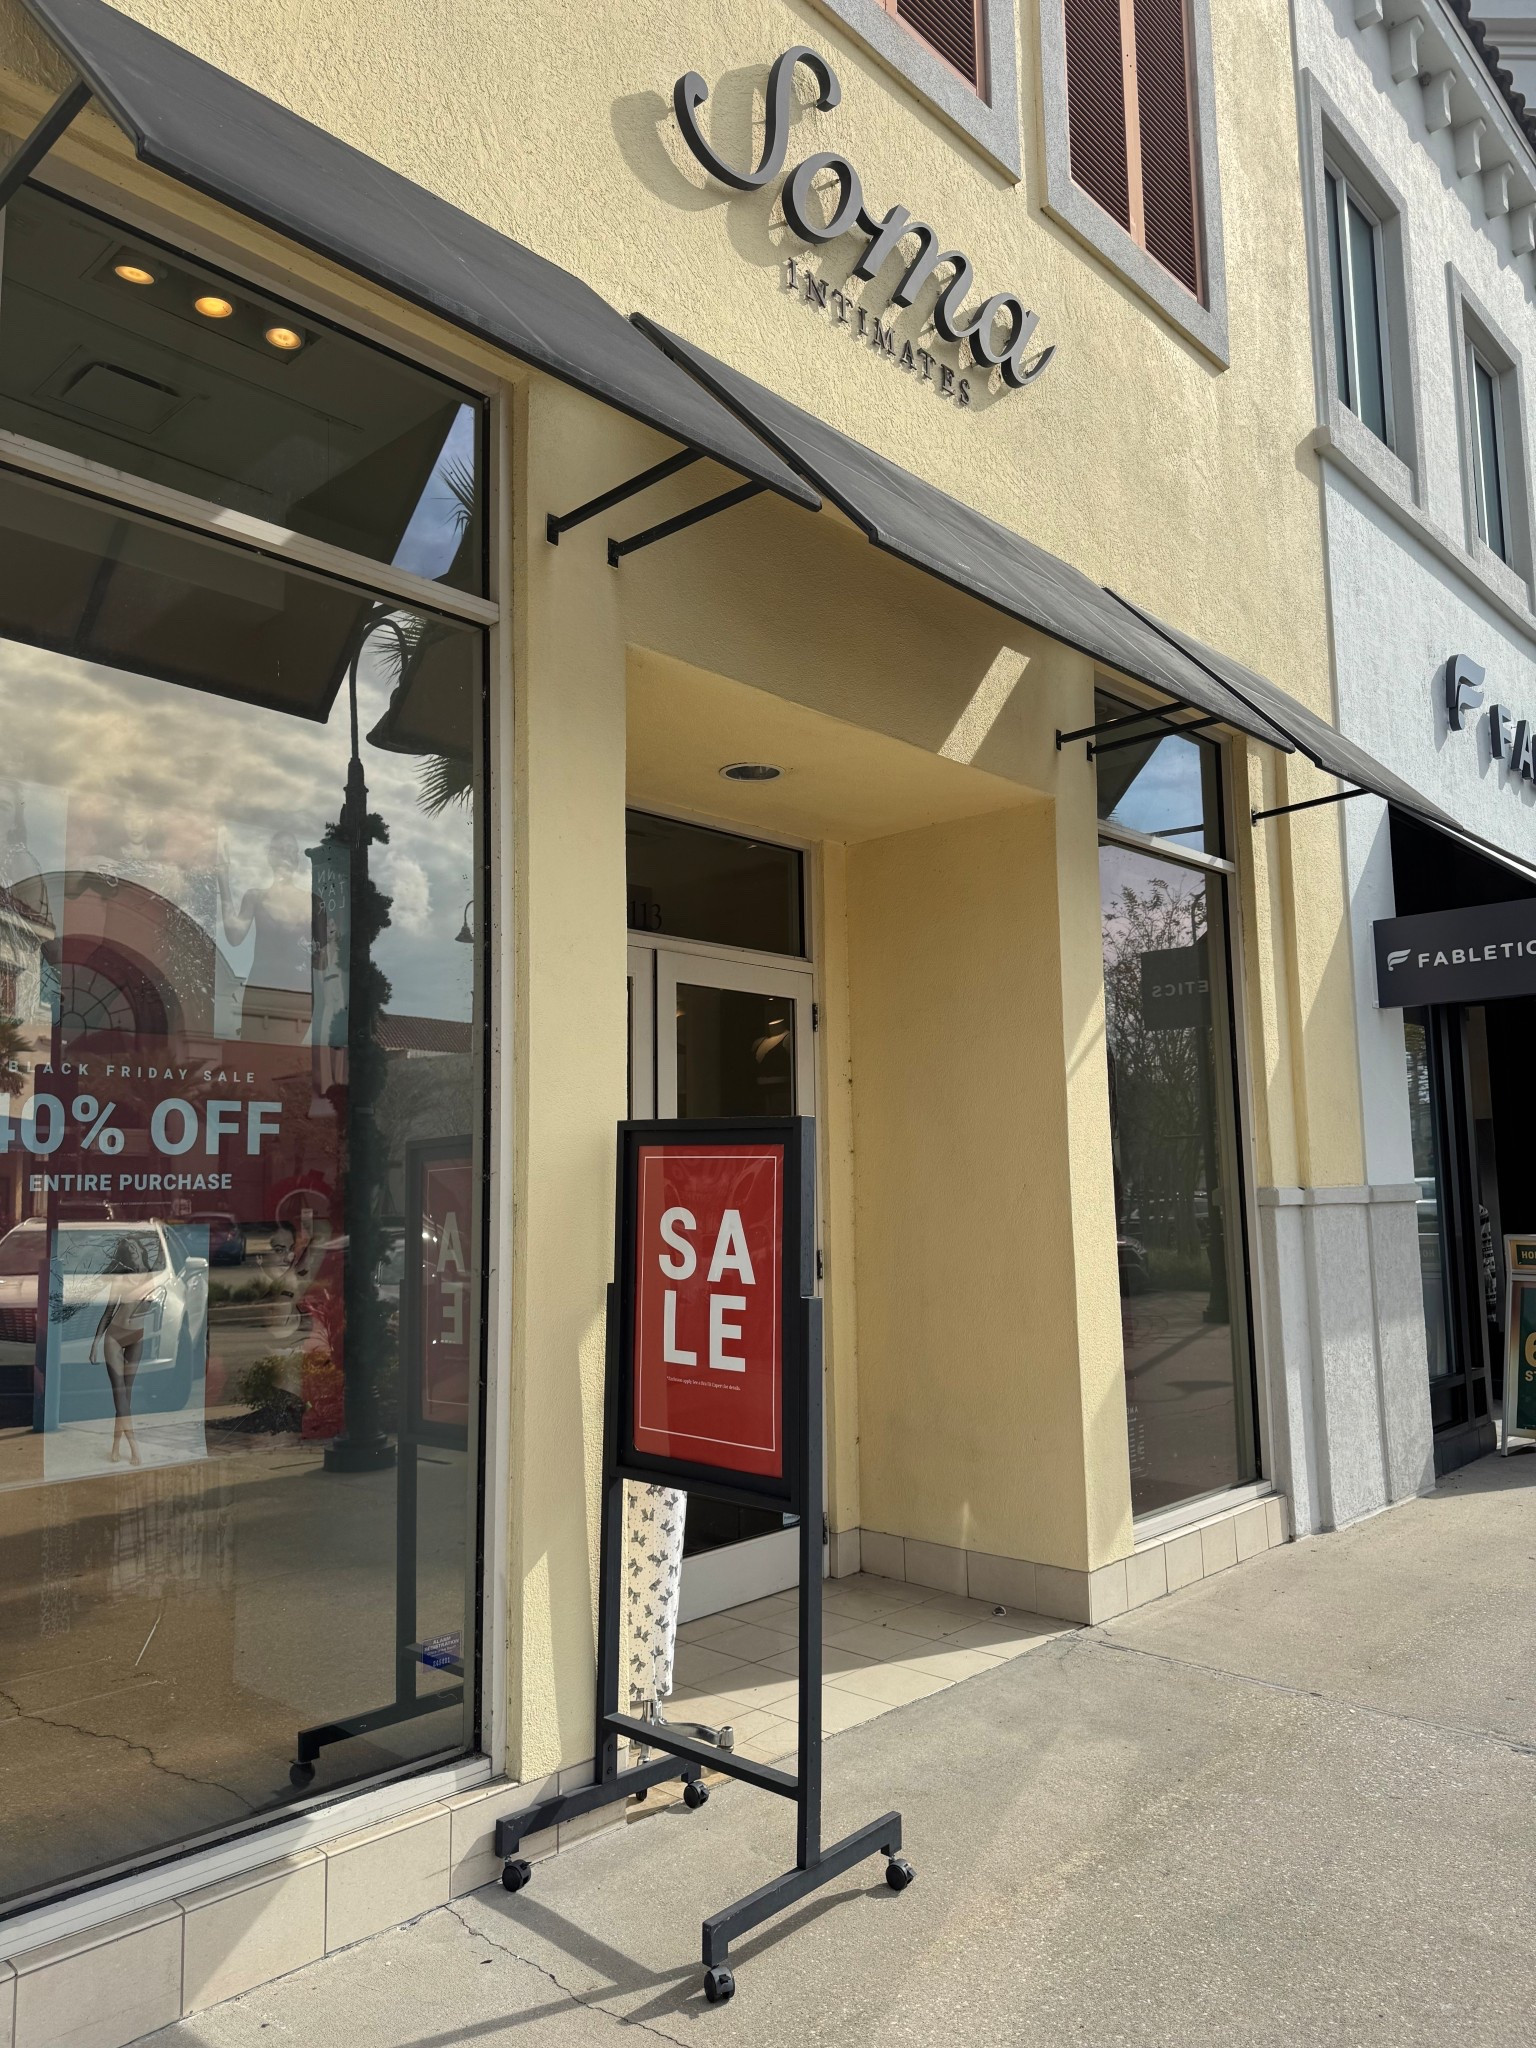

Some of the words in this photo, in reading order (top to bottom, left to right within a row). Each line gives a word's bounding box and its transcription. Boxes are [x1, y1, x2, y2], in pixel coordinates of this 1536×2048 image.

[674, 46, 1055, 389] Soma
[786, 256, 971, 405] INTIMATES
[1489, 703, 1536, 783] FA
[8, 1060, 90, 1076] BLACK
[106, 1065, 189, 1081] FRIDAY
[203, 1070, 256, 1084] SALE
[150, 1098, 283, 1156] OFF
[29, 1173, 112, 1192] ENTIRE
[119, 1173, 233, 1191] PURCHASE
